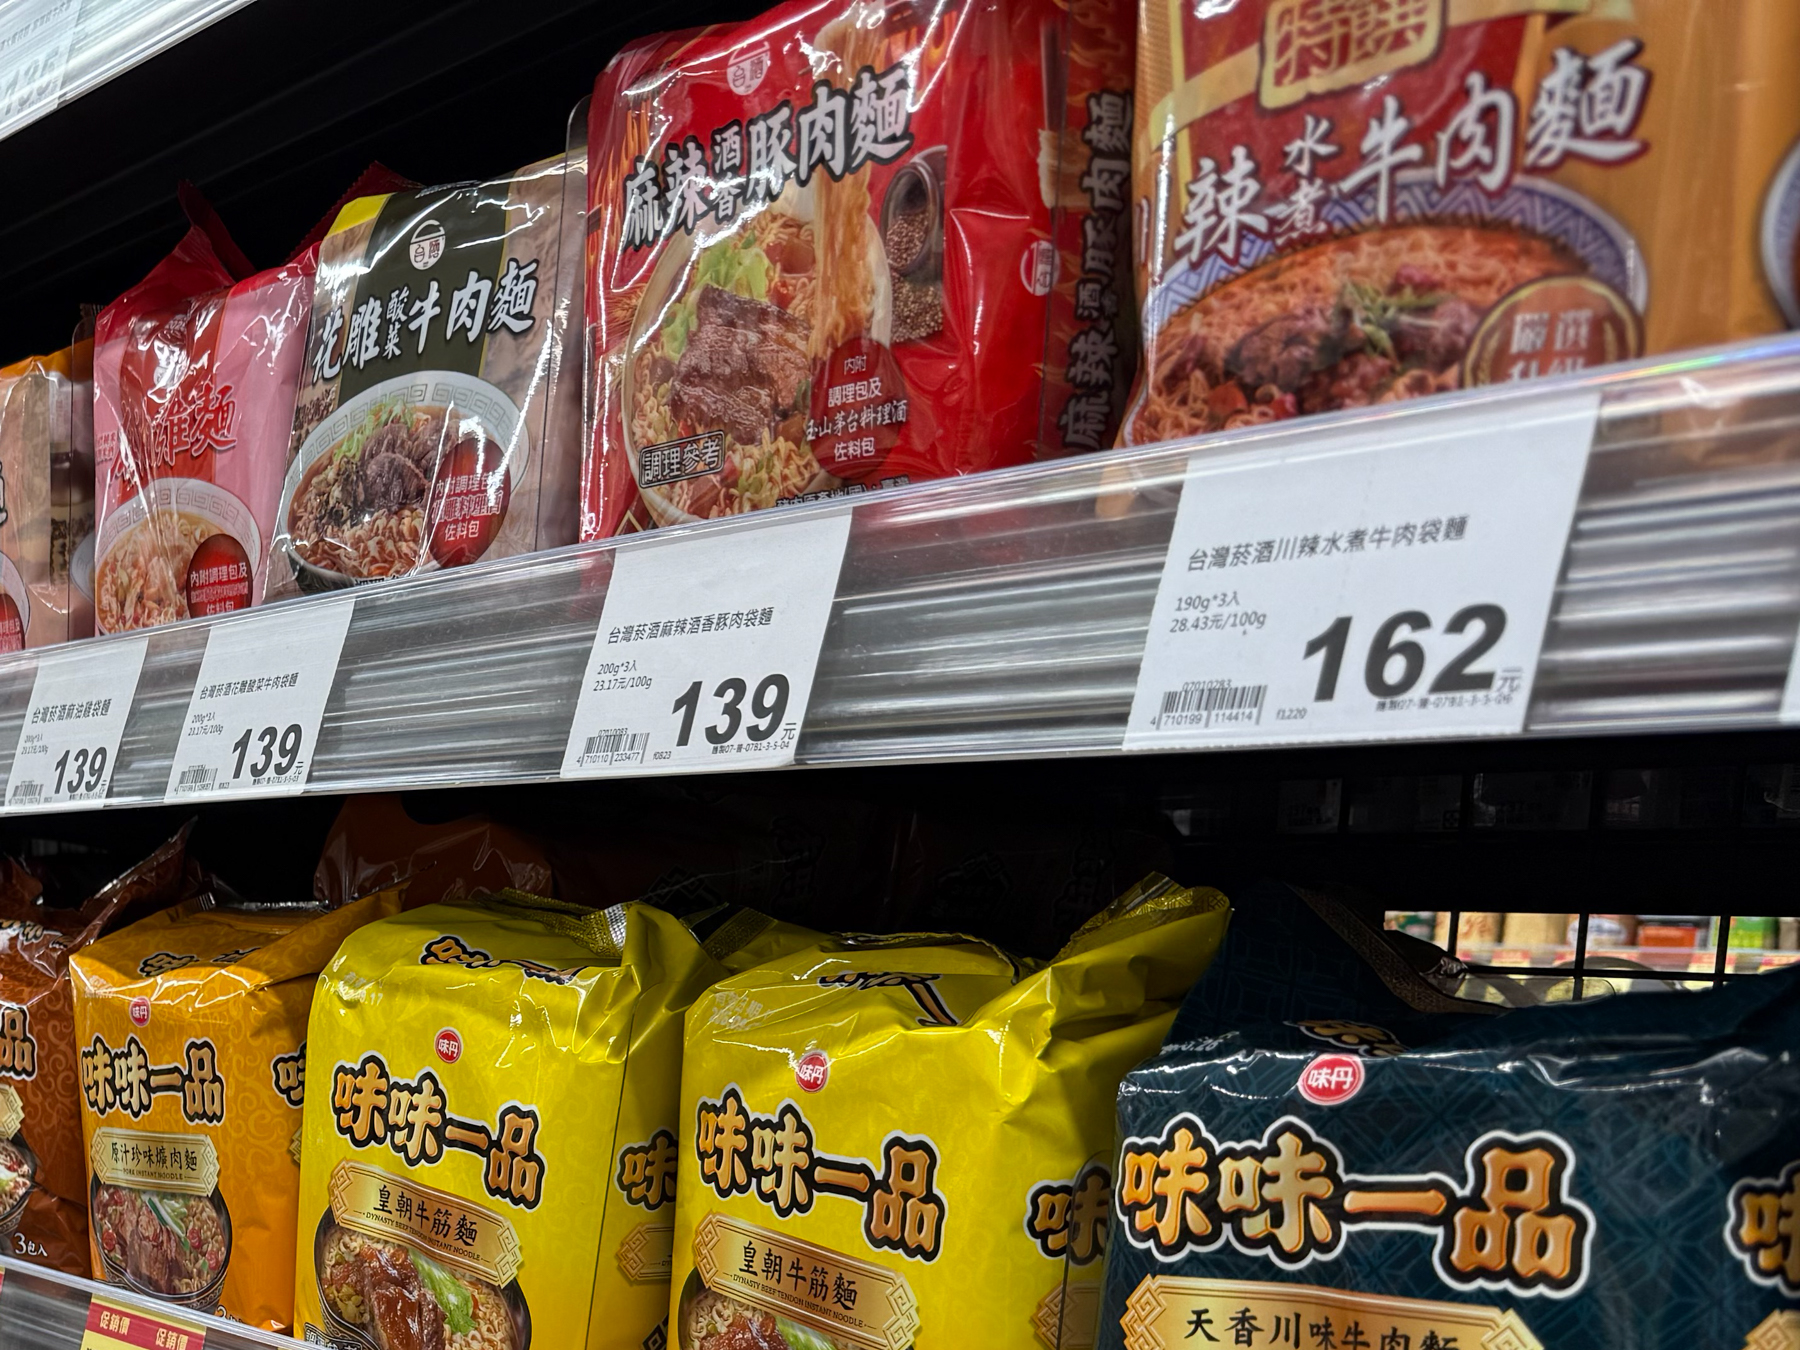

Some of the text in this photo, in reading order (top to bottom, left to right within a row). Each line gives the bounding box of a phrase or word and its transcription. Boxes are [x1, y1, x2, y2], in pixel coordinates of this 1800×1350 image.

[622, 66, 914, 250] 麻辣酒香豚肉麵
[310, 258, 540, 385] 花雕酸菜牛肉麵
[1509, 308, 1594, 352] 嚴選
[827, 376, 883, 408] 調理包及
[834, 437, 876, 463] 佐料包
[1186, 514, 1470, 572] 台灣菸酒川辣水煮牛肉袋麵
[607, 606, 775, 645] 台灣菸酒麻辣酒香豚肉袋麵
[1169, 611, 1268, 636] 28.43元/100g
[1302, 603, 1508, 702] 162
[592, 676, 653, 693] 23.17元/100g
[671, 673, 798, 747] 139 元
[53, 746, 108, 795] 139
[231, 722, 302, 781] 139
[437, 1038, 459, 1058] 味丹
[799, 1064, 824, 1085] 味丹
[80, 1034, 227, 1126] 味味一品
[1306, 1066, 1354, 1091] 味丹
[331, 1050, 548, 1211] 味味一品
[696, 1084, 948, 1264] 味味一品
[372, 1183, 479, 1247] 皇朝牛筋麵
[1117, 1113, 1595, 1297] 味味一品
[733, 1273, 761, 1290] DYNASTY
[760, 1283, 778, 1296] BEEF
[804, 1299, 833, 1316] INSTANT
[833, 1309, 864, 1328] NOODLE
[738, 1240, 858, 1311] 皇朝牛筋麵
[99, 1310, 130, 1337] 促銷價
